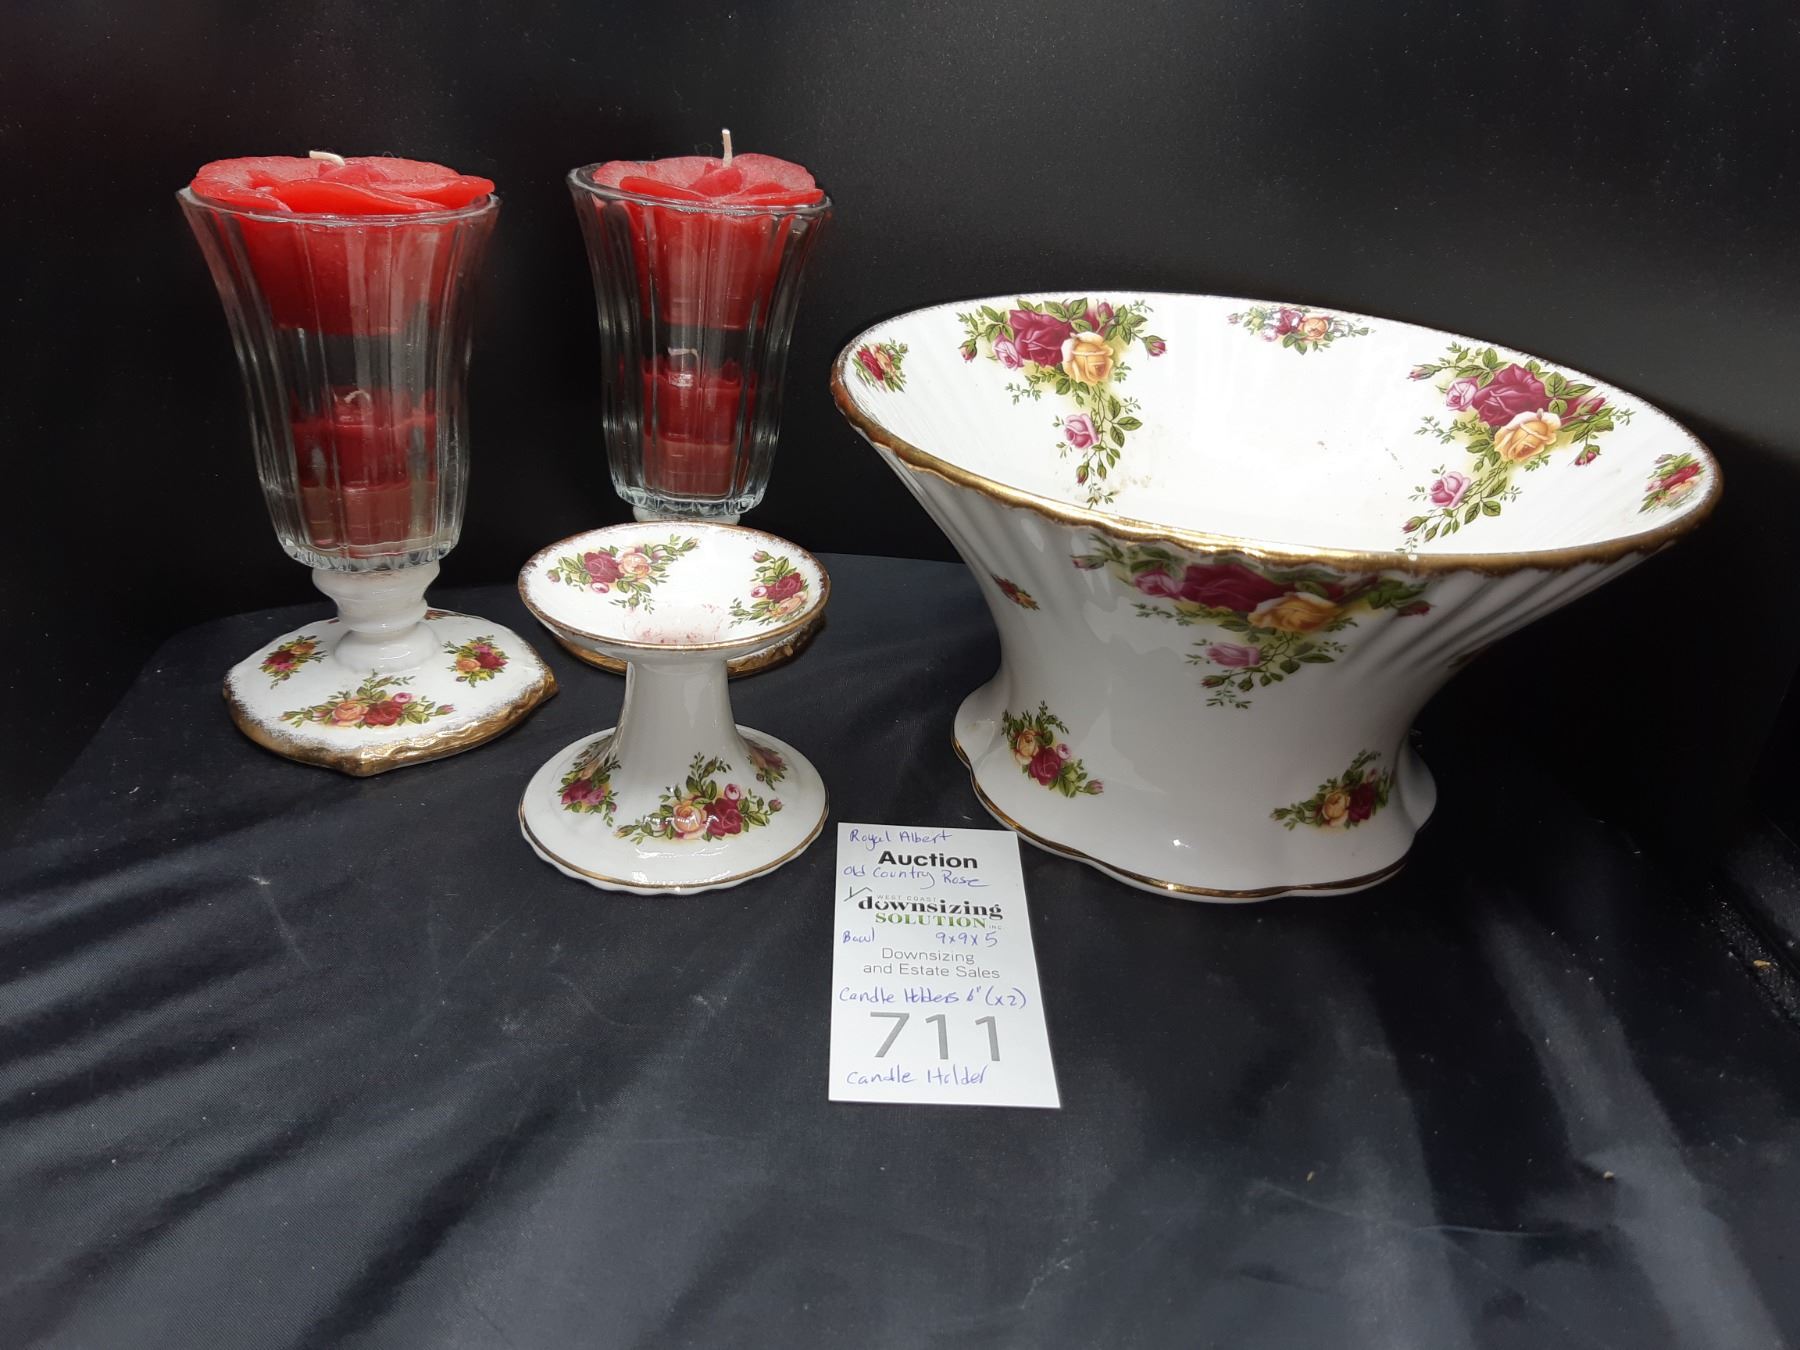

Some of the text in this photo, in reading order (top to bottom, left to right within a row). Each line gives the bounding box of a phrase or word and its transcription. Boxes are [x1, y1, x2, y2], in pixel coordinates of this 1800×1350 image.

[900, 830, 952, 844] Albert
[878, 851, 978, 869] Auction
[843, 866, 865, 877] Old
[873, 866, 935, 889] Country
[858, 896, 1004, 920] downsizing
[875, 912, 986, 929] SOLUTION
[882, 947, 974, 964] Downsizing
[863, 963, 1000, 979] and Estate Sales
[839, 986, 895, 1003] Candle
[870, 1011, 1001, 1062] 711
[927, 1064, 988, 1085] Holder
